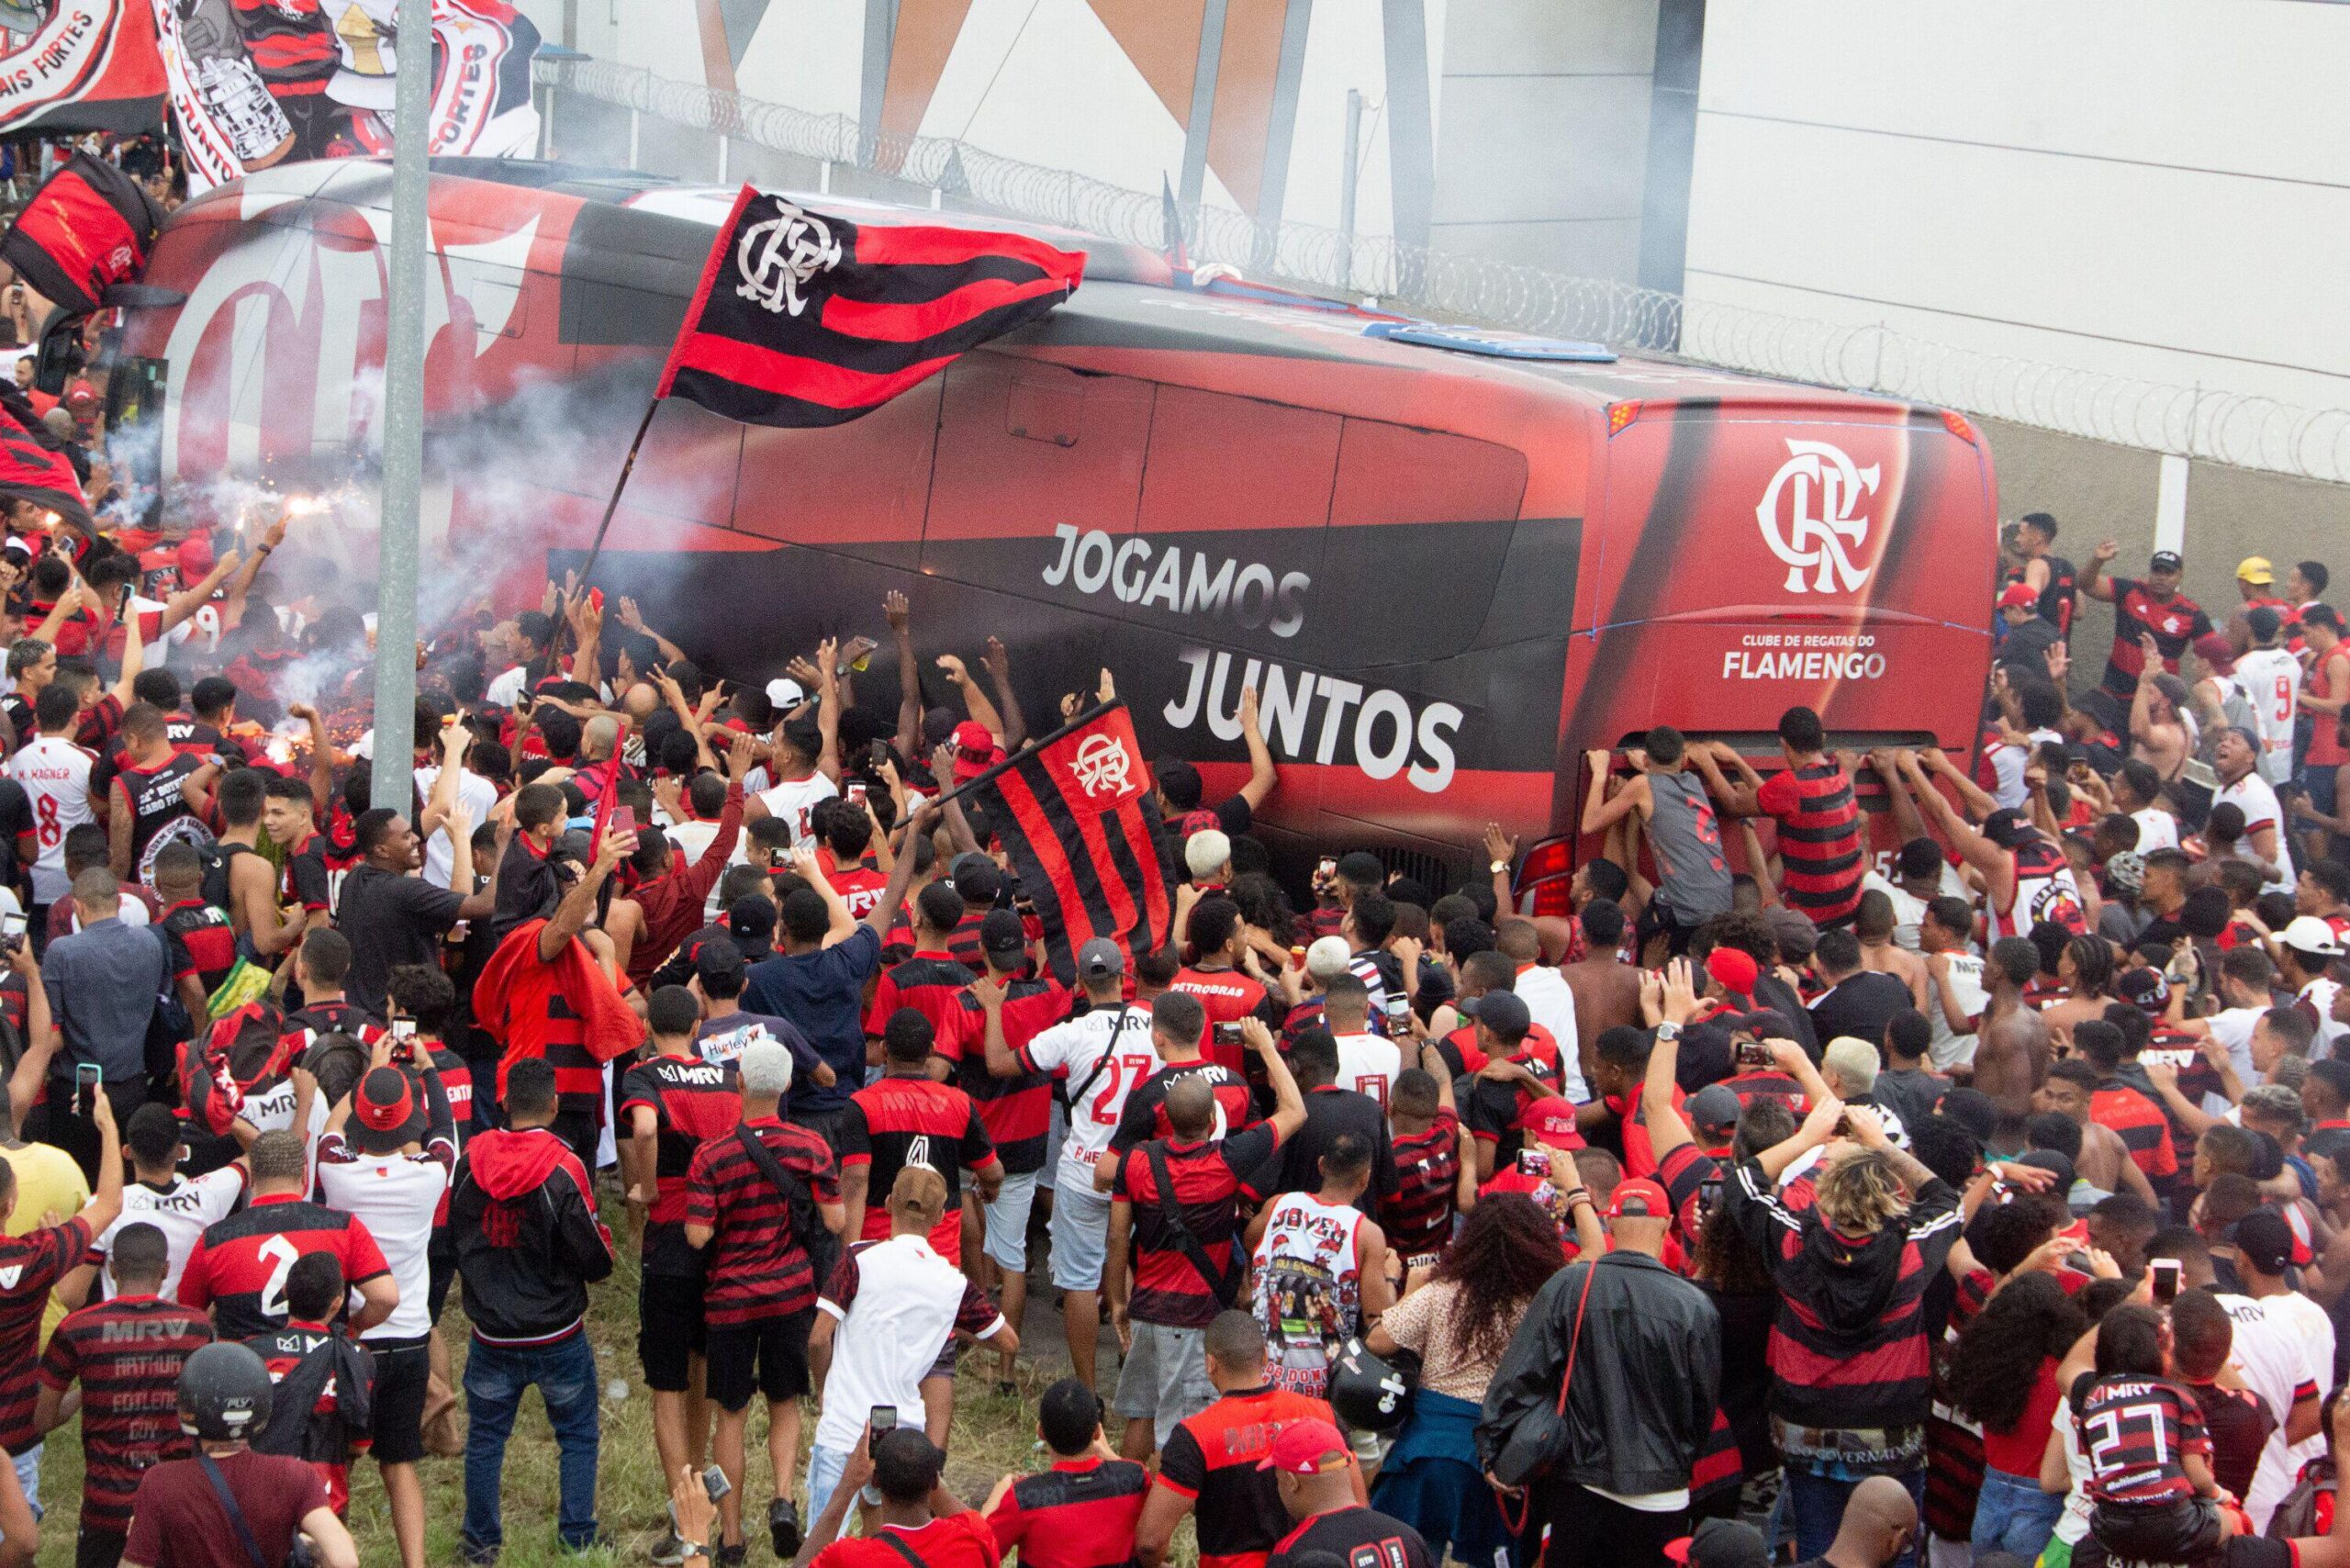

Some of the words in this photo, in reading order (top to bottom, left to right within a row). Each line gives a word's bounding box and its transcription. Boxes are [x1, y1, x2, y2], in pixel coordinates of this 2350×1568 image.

[32, 10, 93, 80] FORTES
[174, 93, 241, 182] JUNTO
[1042, 522, 1312, 638] JOGAMOS
[1742, 634, 1781, 647] CLUBE
[1784, 634, 1802, 647] DE
[1804, 634, 1855, 648] REGATAS
[1857, 634, 1875, 648] DO
[1722, 652, 1886, 679] FLAMENGO
[2276, 675, 2292, 722] 9
[167, 724, 196, 740] RV
[1163, 646, 1464, 794] JUNTOS
[38, 792, 62, 848] 8
[1170, 981, 1245, 998] PETROBRAS
[708, 1037, 748, 1057] Hurley
[677, 1065, 725, 1085] MRV
[1091, 1054, 1152, 1126] 27
[259, 1092, 297, 1117] MR
[1270, 1207, 1348, 1247] JOVEM
[258, 1233, 299, 1316] 2
[102, 1318, 190, 1344] MRV
[2107, 1383, 2156, 1401] MRV
[2084, 1403, 2168, 1479] 27
